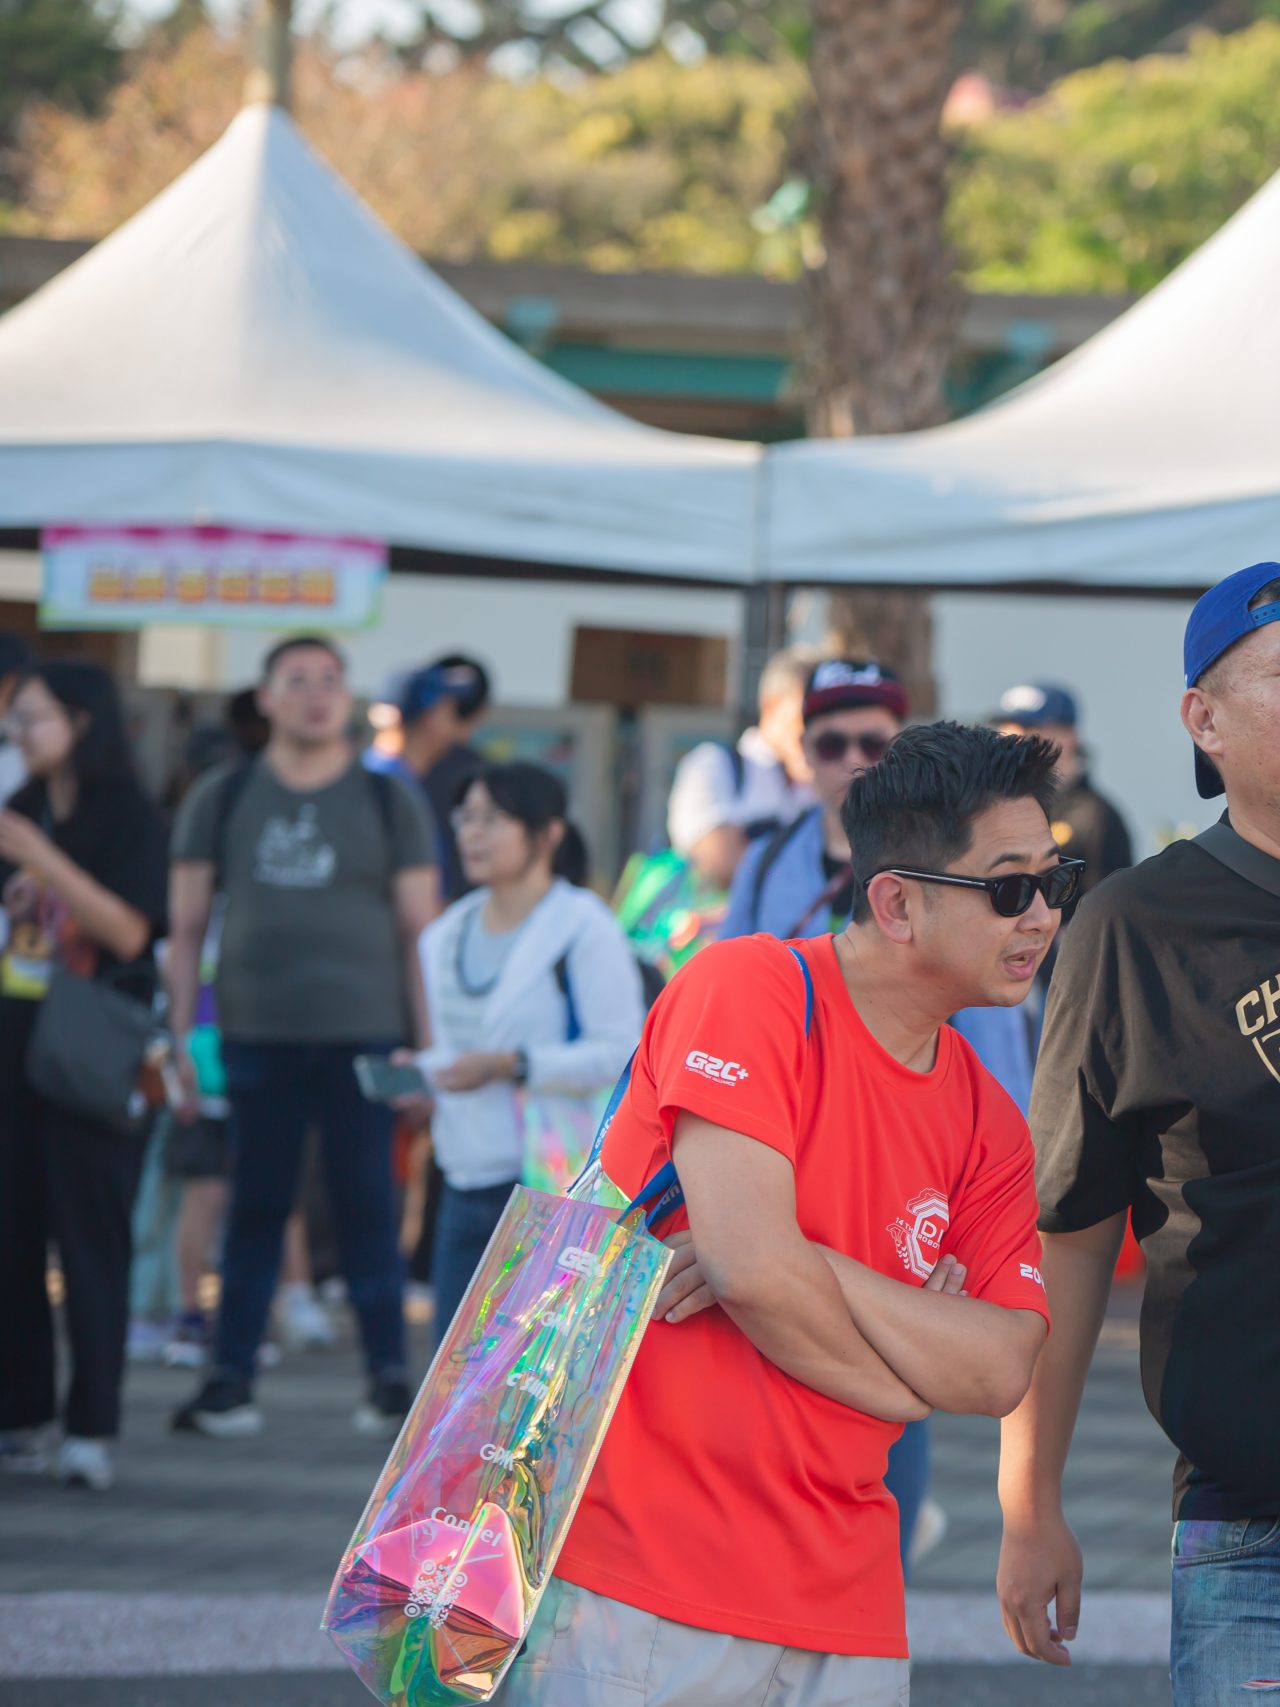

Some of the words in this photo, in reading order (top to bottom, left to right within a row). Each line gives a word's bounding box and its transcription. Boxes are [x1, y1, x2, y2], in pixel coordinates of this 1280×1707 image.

[685, 1050, 749, 1082] G2C+
[917, 1234, 940, 1249] ROBO
[1019, 1263, 1047, 1294] 20
